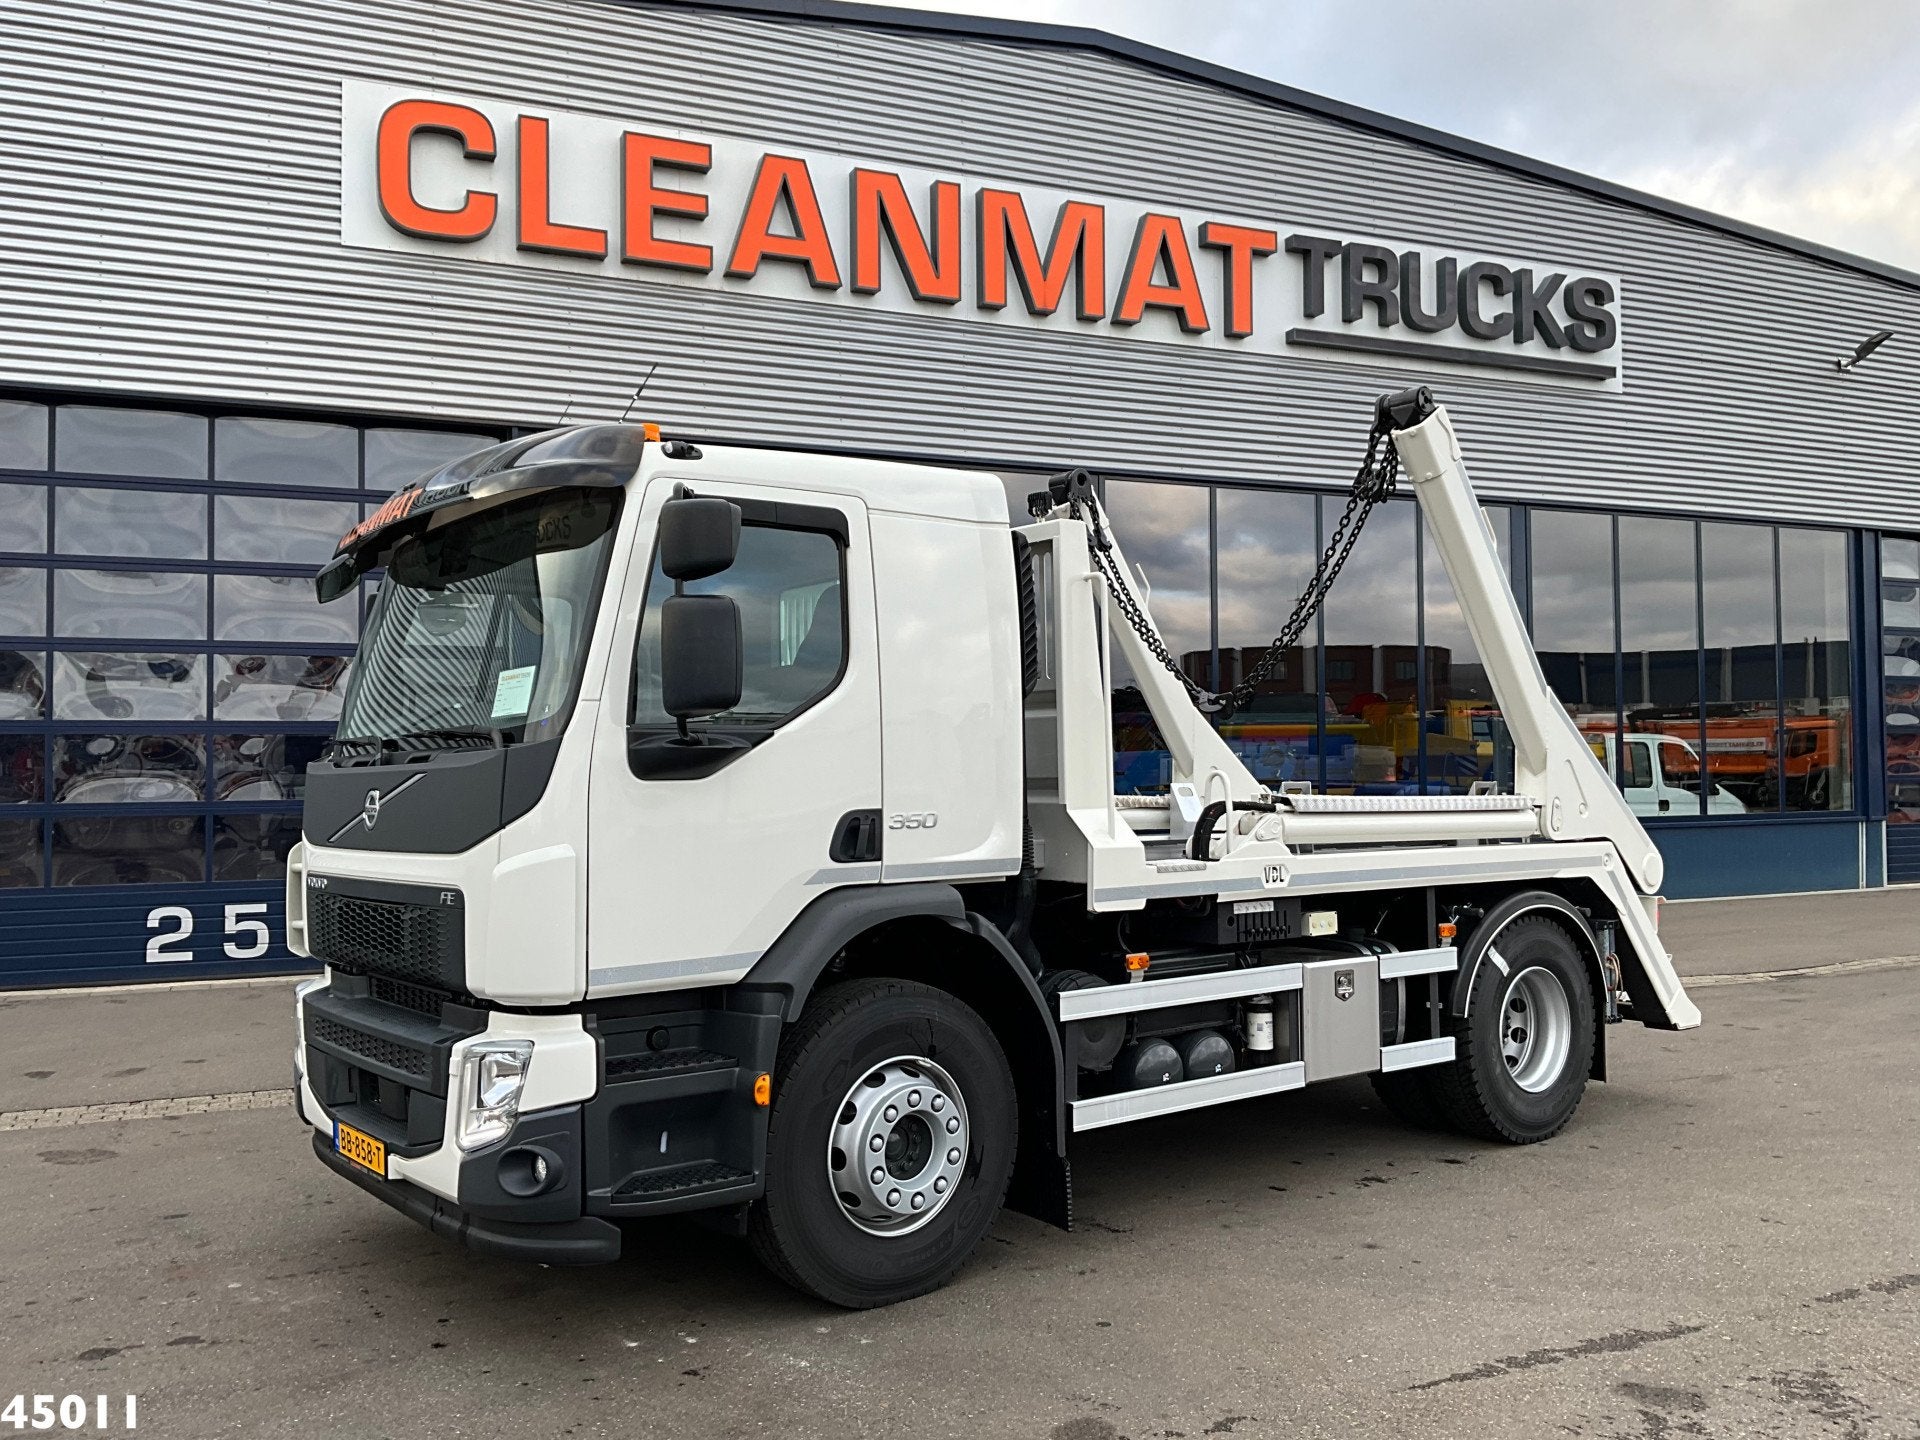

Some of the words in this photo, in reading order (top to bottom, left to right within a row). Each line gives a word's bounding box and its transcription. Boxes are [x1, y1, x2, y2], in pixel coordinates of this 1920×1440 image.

[376, 98, 1278, 339] CLEANMAT
[1285, 233, 1617, 353] TRUCKS
[887, 812, 938, 830] 350
[1264, 866, 1285, 884] VDL
[439, 890, 456, 906] FE
